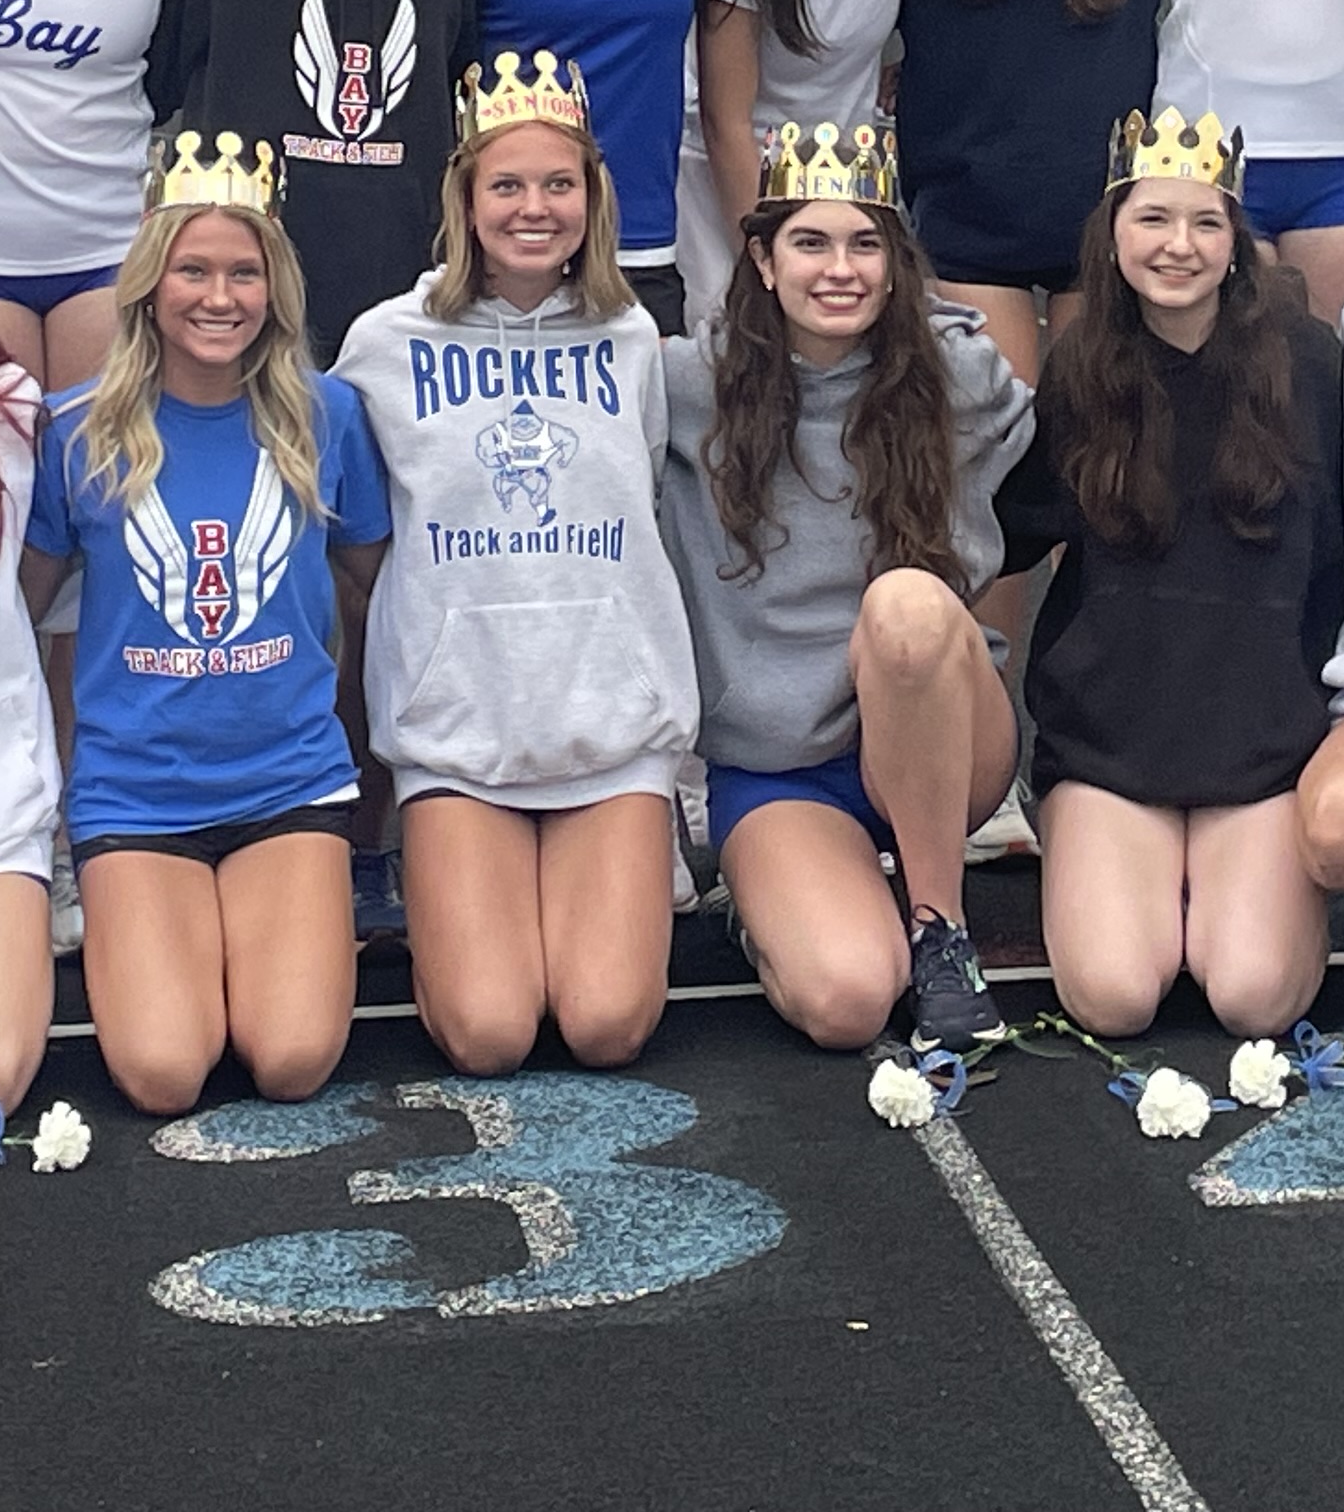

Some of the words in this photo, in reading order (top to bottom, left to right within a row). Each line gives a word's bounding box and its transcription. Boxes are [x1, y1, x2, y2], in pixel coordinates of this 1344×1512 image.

[338, 41, 373, 134] BAY
[282, 133, 346, 165] TRACK
[346, 141, 362, 165] &
[409, 339, 622, 422] ROCKETS
[191, 519, 232, 638] BAY
[427, 521, 502, 566] Track
[509, 524, 560, 554] and
[566, 516, 625, 563] Field
[122, 645, 206, 679] TRACK
[208, 647, 229, 676] &
[230, 633, 294, 675] FIELD
[148, 1071, 790, 1326] 3
